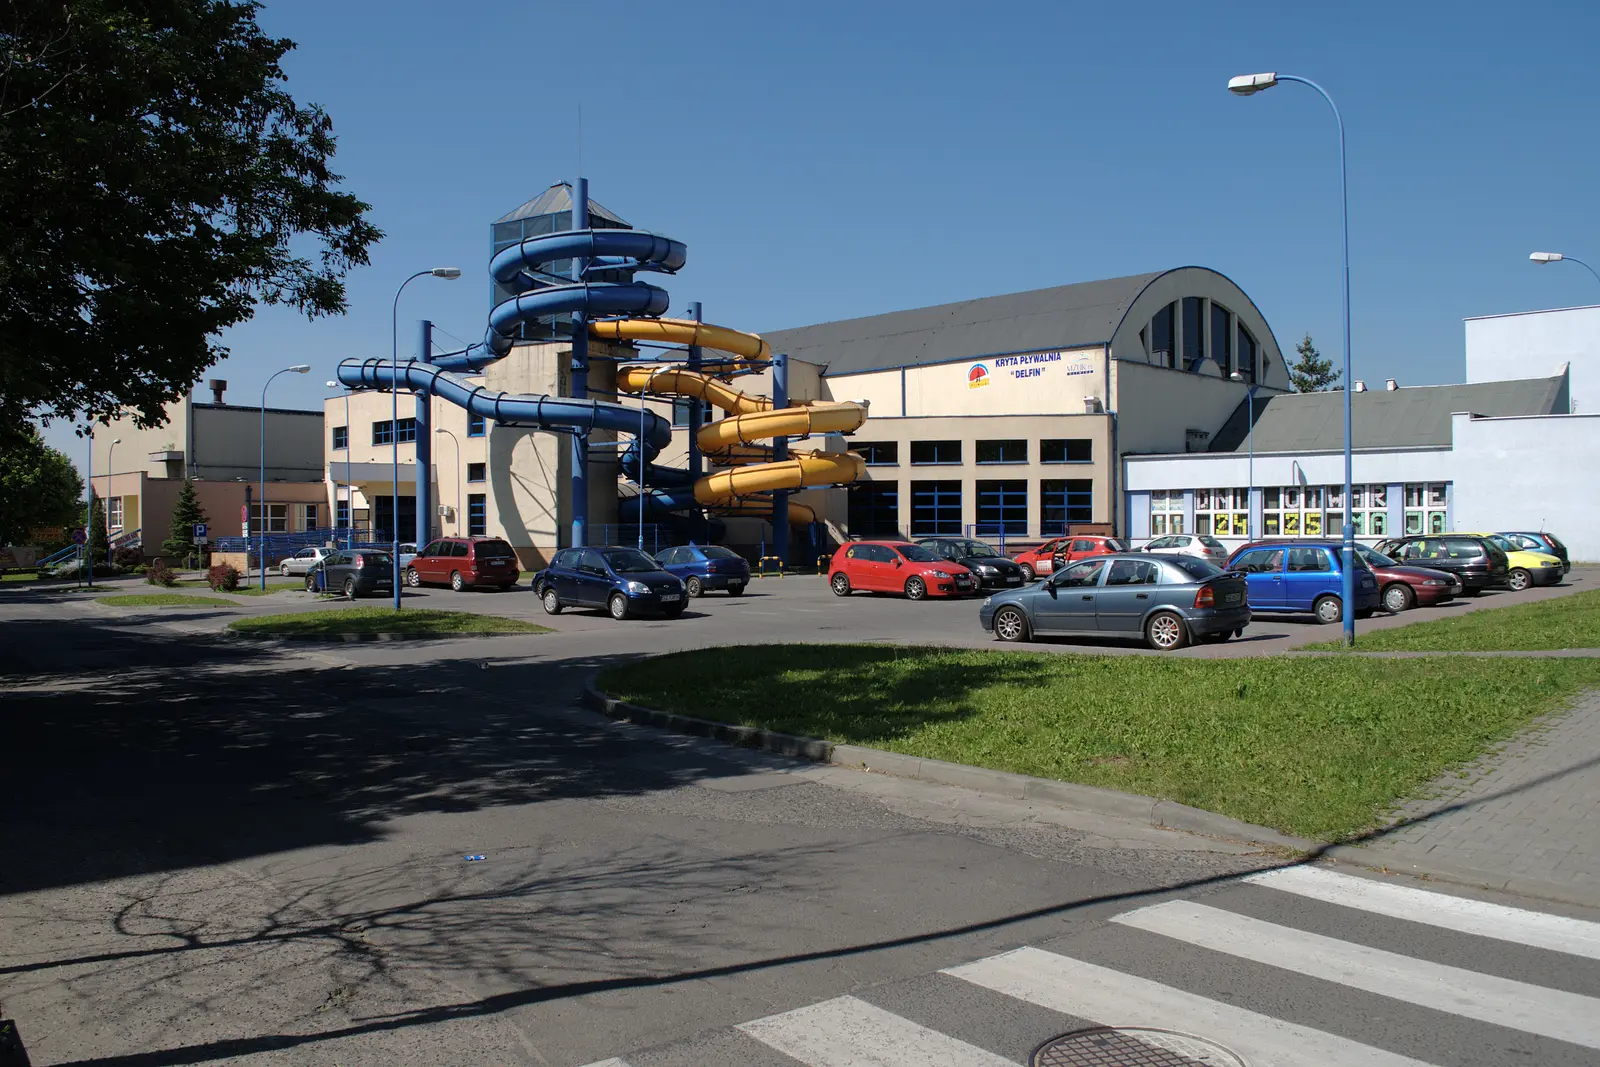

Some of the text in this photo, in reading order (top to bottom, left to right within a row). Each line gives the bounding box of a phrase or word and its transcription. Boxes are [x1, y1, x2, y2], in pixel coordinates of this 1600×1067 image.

[995, 351, 1062, 368] KRYTA PŁYWALNIA
[1197, 487, 1241, 510] DNI
[196, 525, 205, 536] P
[1216, 513, 1247, 535] 24
[1285, 512, 1321, 535] 25
[1351, 511, 1445, 535] MAJA
